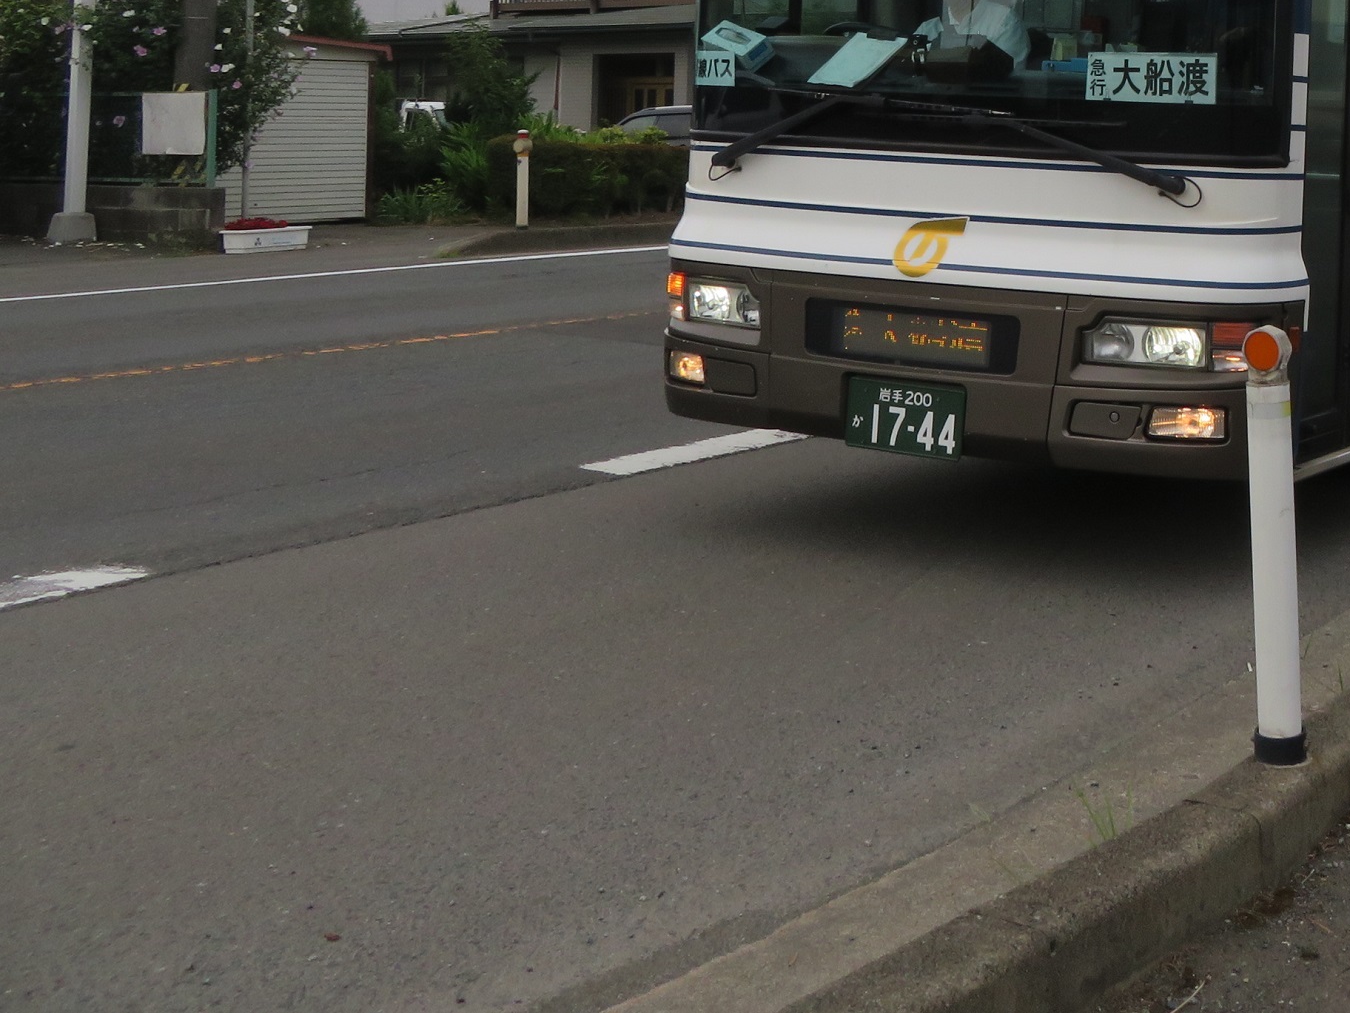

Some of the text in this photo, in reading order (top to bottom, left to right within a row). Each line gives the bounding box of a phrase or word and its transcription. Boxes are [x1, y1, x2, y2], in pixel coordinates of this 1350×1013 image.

[1089, 58, 1107, 97] 急行
[1112, 58, 1209, 97] 大船渡
[852, 403, 956, 454] か 17-44
